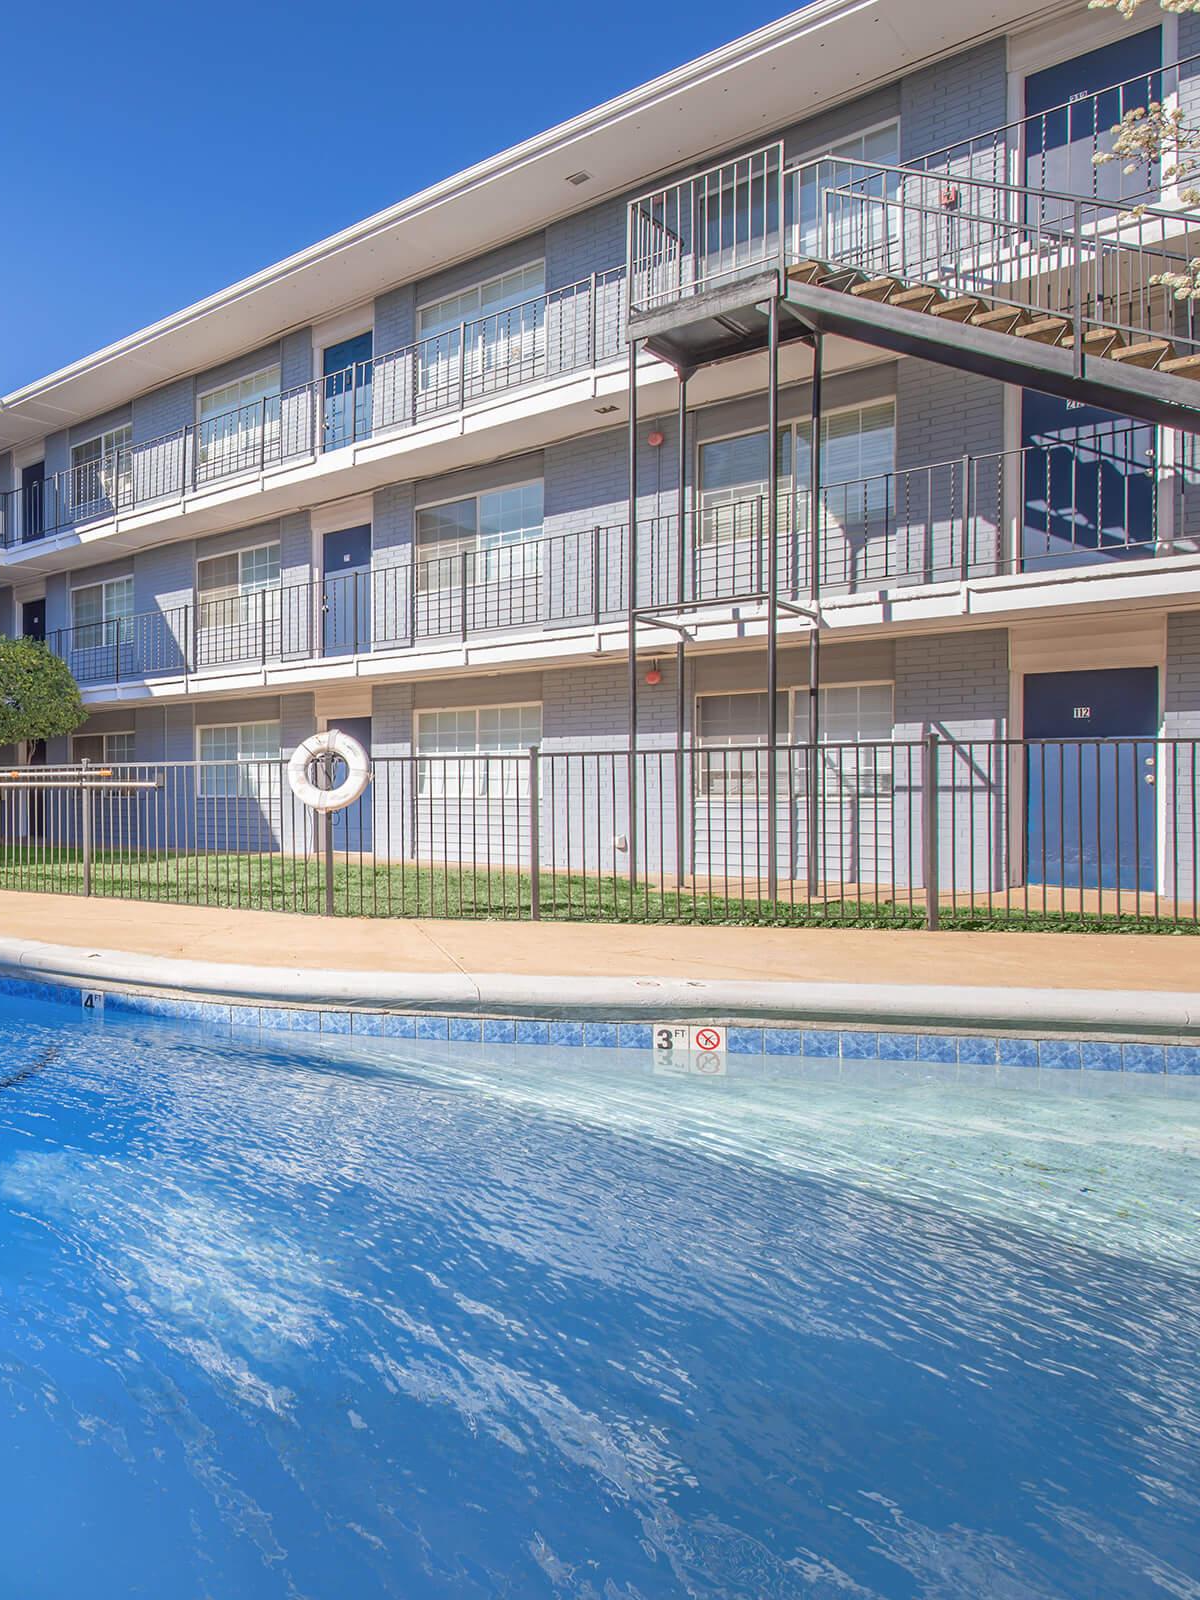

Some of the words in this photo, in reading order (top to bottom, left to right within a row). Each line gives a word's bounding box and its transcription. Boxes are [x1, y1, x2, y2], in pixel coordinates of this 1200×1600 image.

[1073, 707, 1090, 719] 112
[84, 993, 95, 1008] 4
[657, 1029, 673, 1050] 3
[674, 1029, 685, 1038] FT
